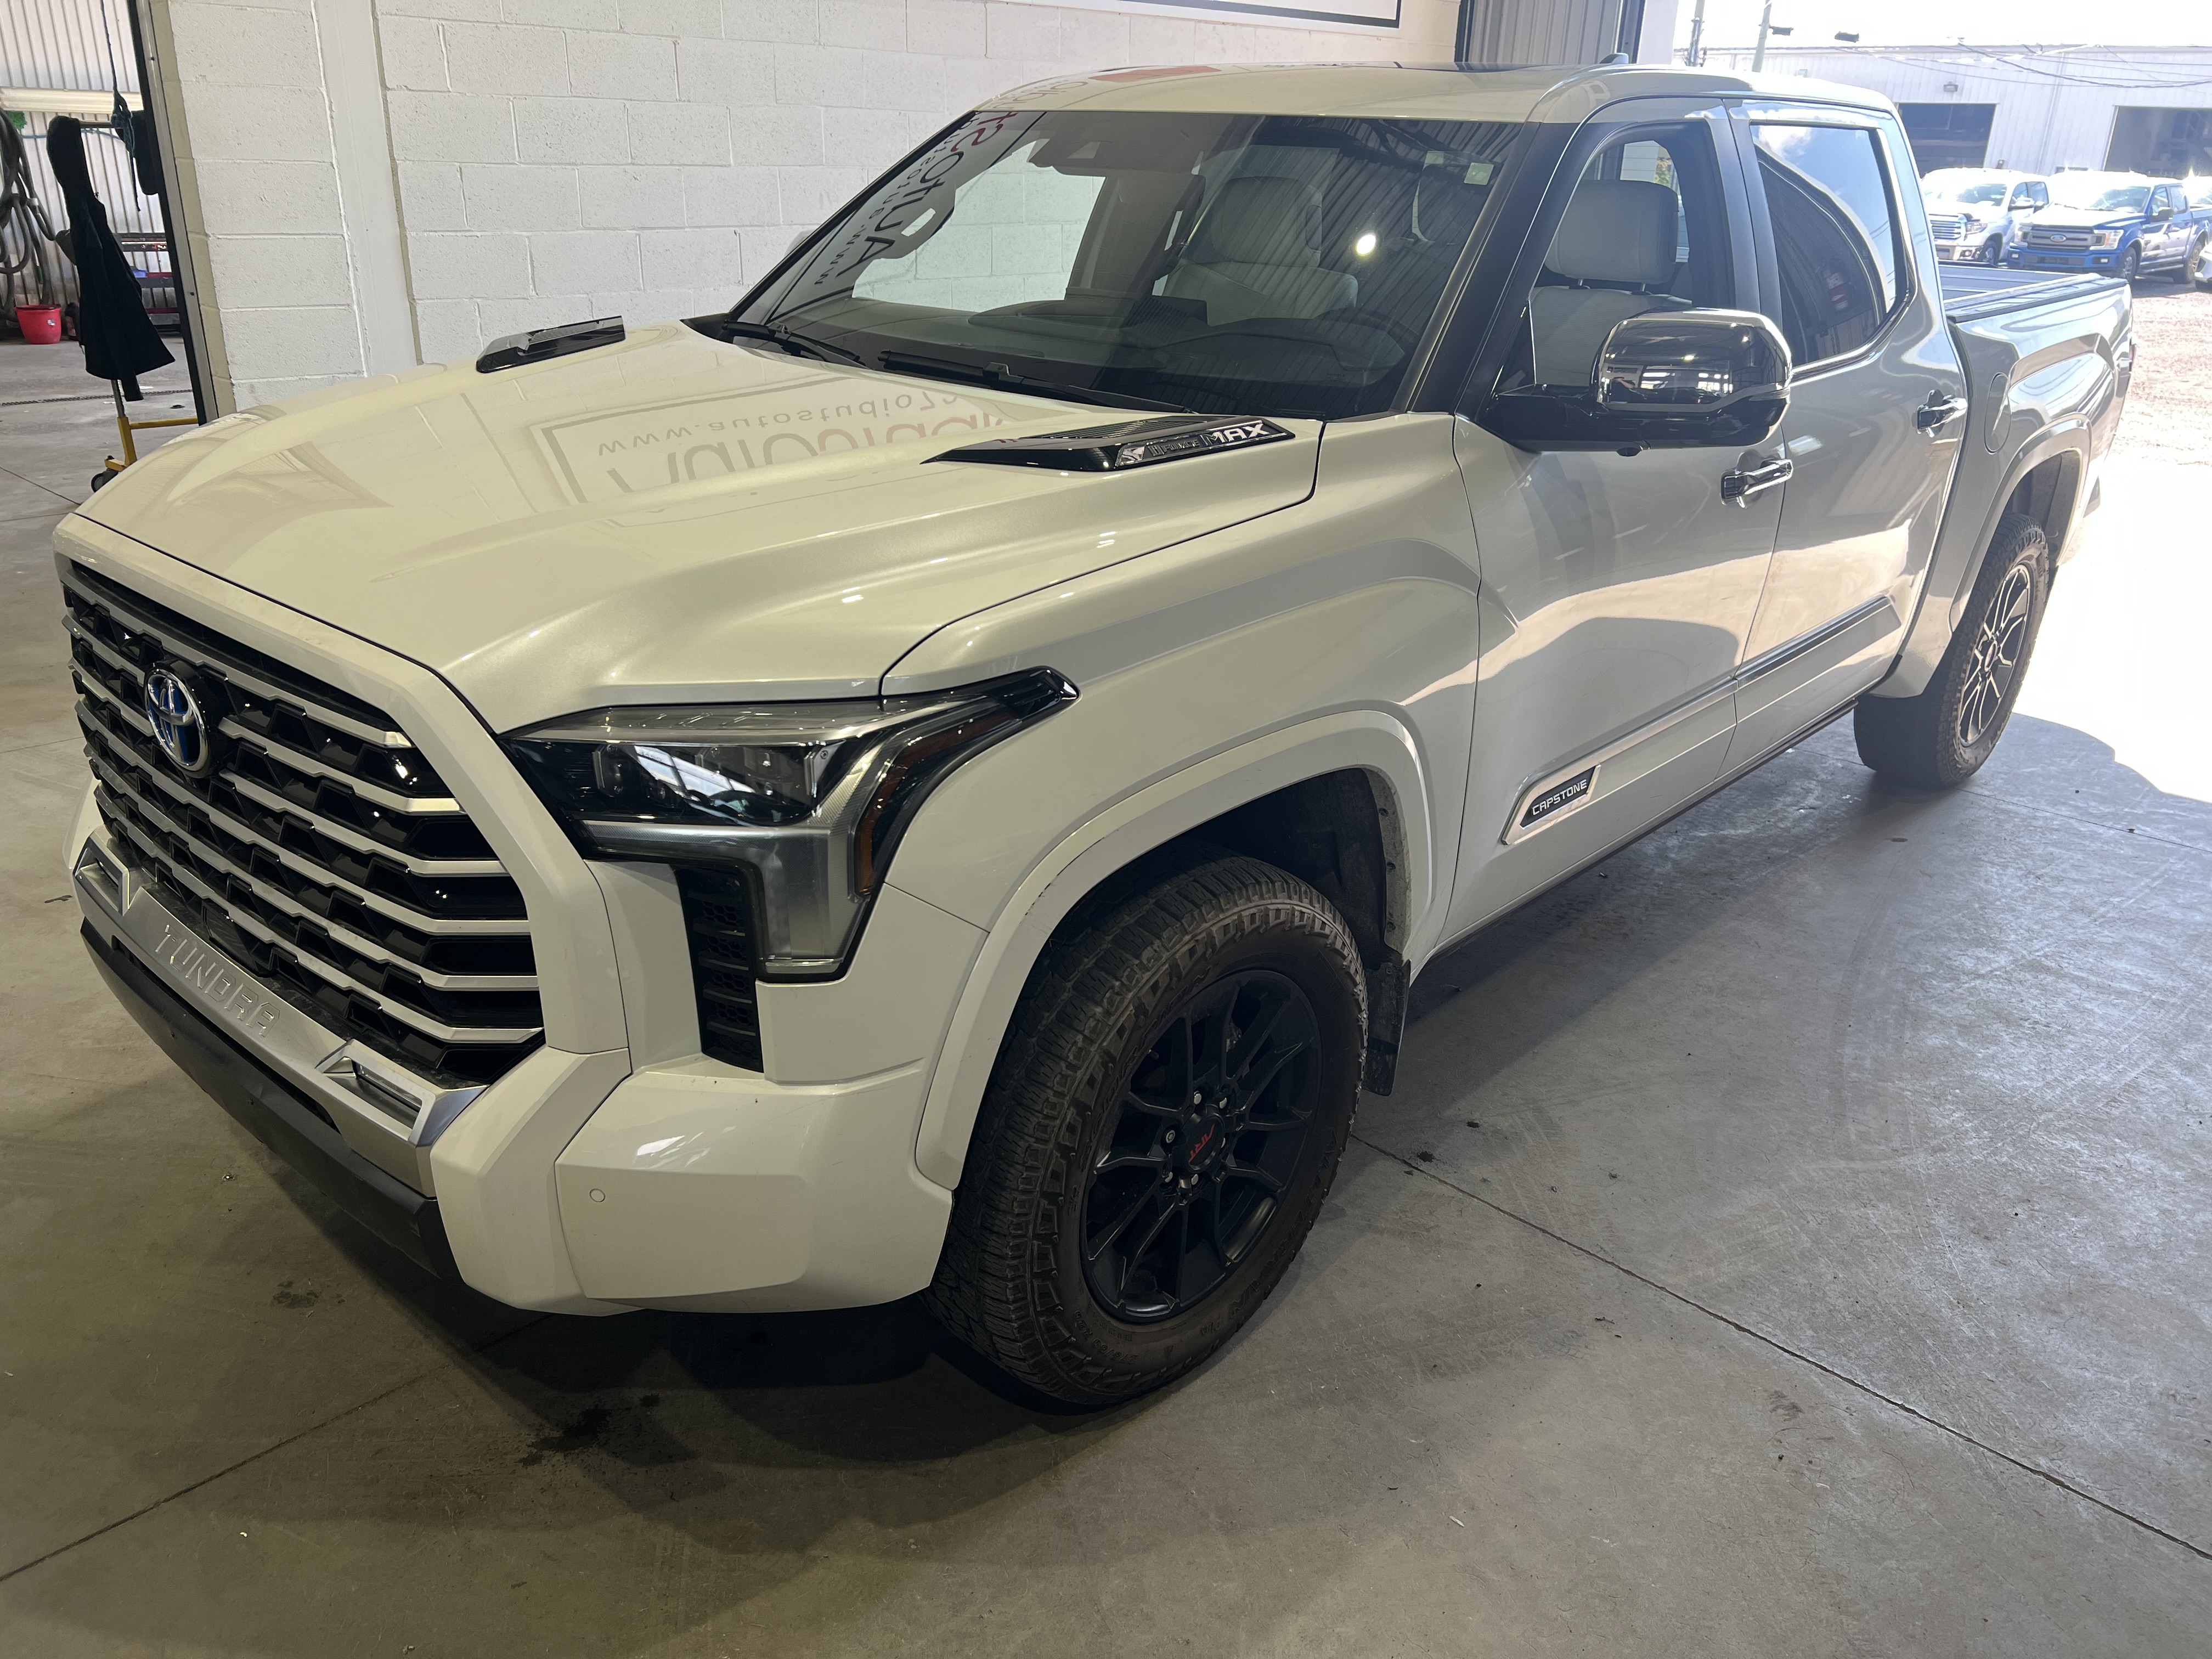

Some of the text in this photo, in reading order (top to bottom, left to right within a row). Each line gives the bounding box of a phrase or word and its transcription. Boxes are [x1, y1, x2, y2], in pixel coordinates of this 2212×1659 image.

[1200, 423, 1270, 447] MAX
[1532, 779, 1587, 815] CAPSTONE
[155, 924, 281, 1037] TUNDRA
